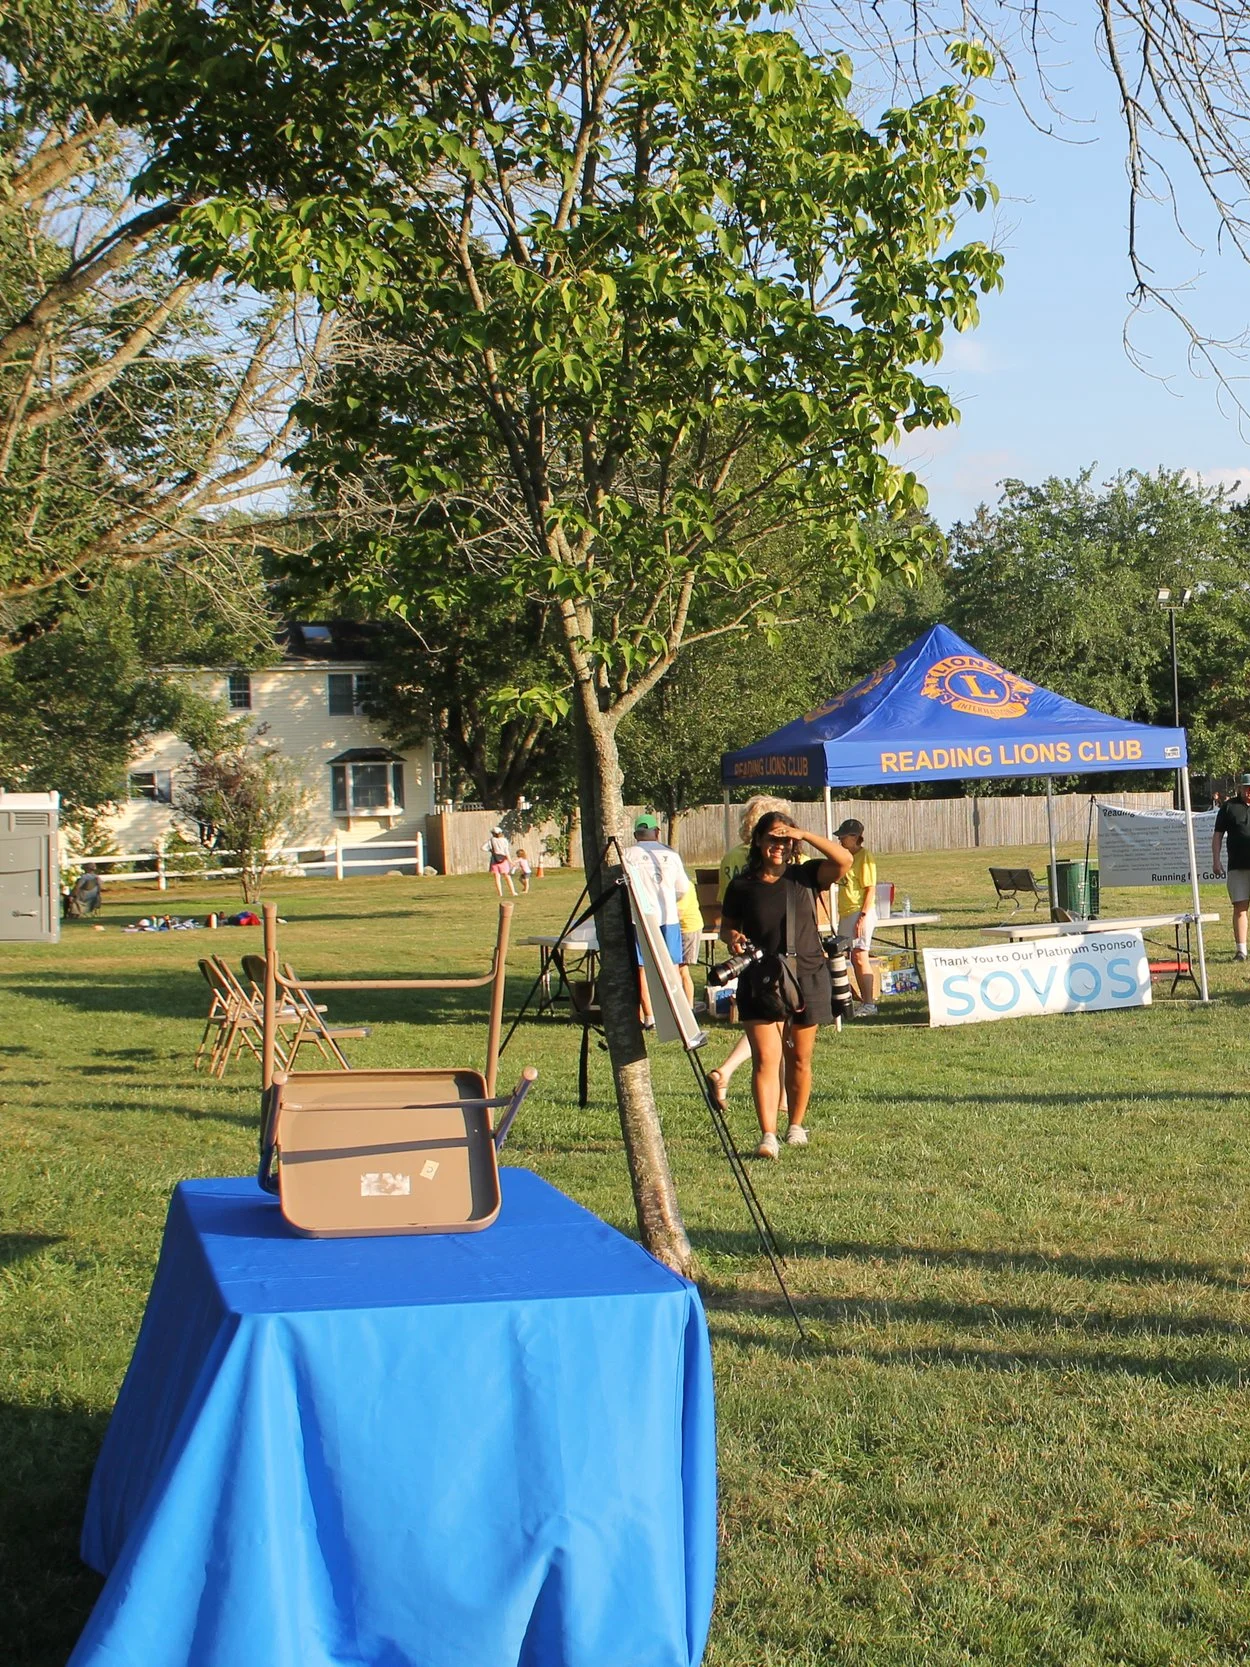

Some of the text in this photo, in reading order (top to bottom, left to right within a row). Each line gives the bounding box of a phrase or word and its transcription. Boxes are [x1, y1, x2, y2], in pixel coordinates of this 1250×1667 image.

[932, 657, 997, 676] LIONS
[959, 674, 999, 699] L
[734, 756, 809, 778] READING LIONS CLUB
[880, 739, 1142, 773] READING LIONS CLUB
[1151, 872, 1226, 882] Running fr Good
[932, 940, 1138, 968] Thank You to Our Platinum Sponsor
